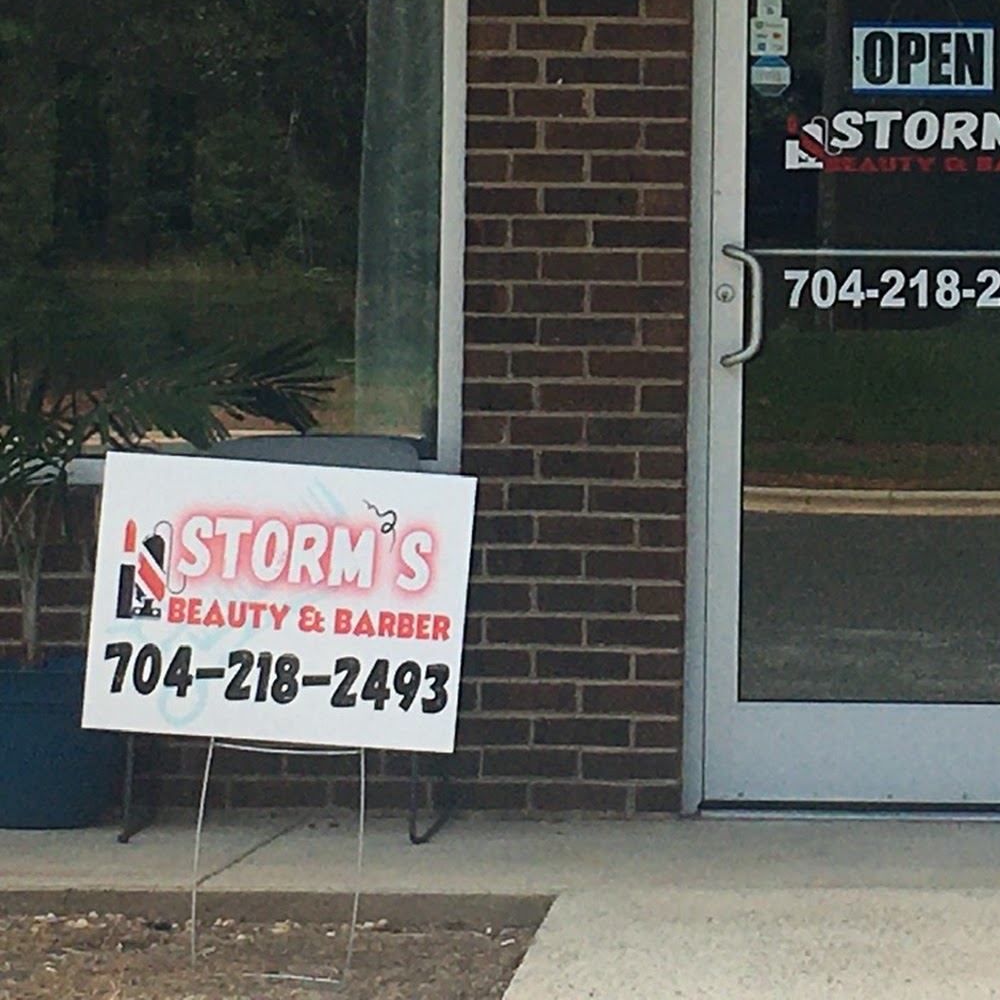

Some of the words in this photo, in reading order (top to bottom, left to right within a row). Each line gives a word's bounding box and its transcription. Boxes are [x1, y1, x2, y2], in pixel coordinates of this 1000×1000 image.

[862, 30, 985, 87] OPEN
[826, 156, 935, 173] BEAUTY
[943, 156, 968, 173] &
[168, 596, 291, 631] BEAUTY
[297, 605, 326, 633] &
[333, 608, 452, 641] BARBER
[104, 641, 451, 714] 704-218-2493
